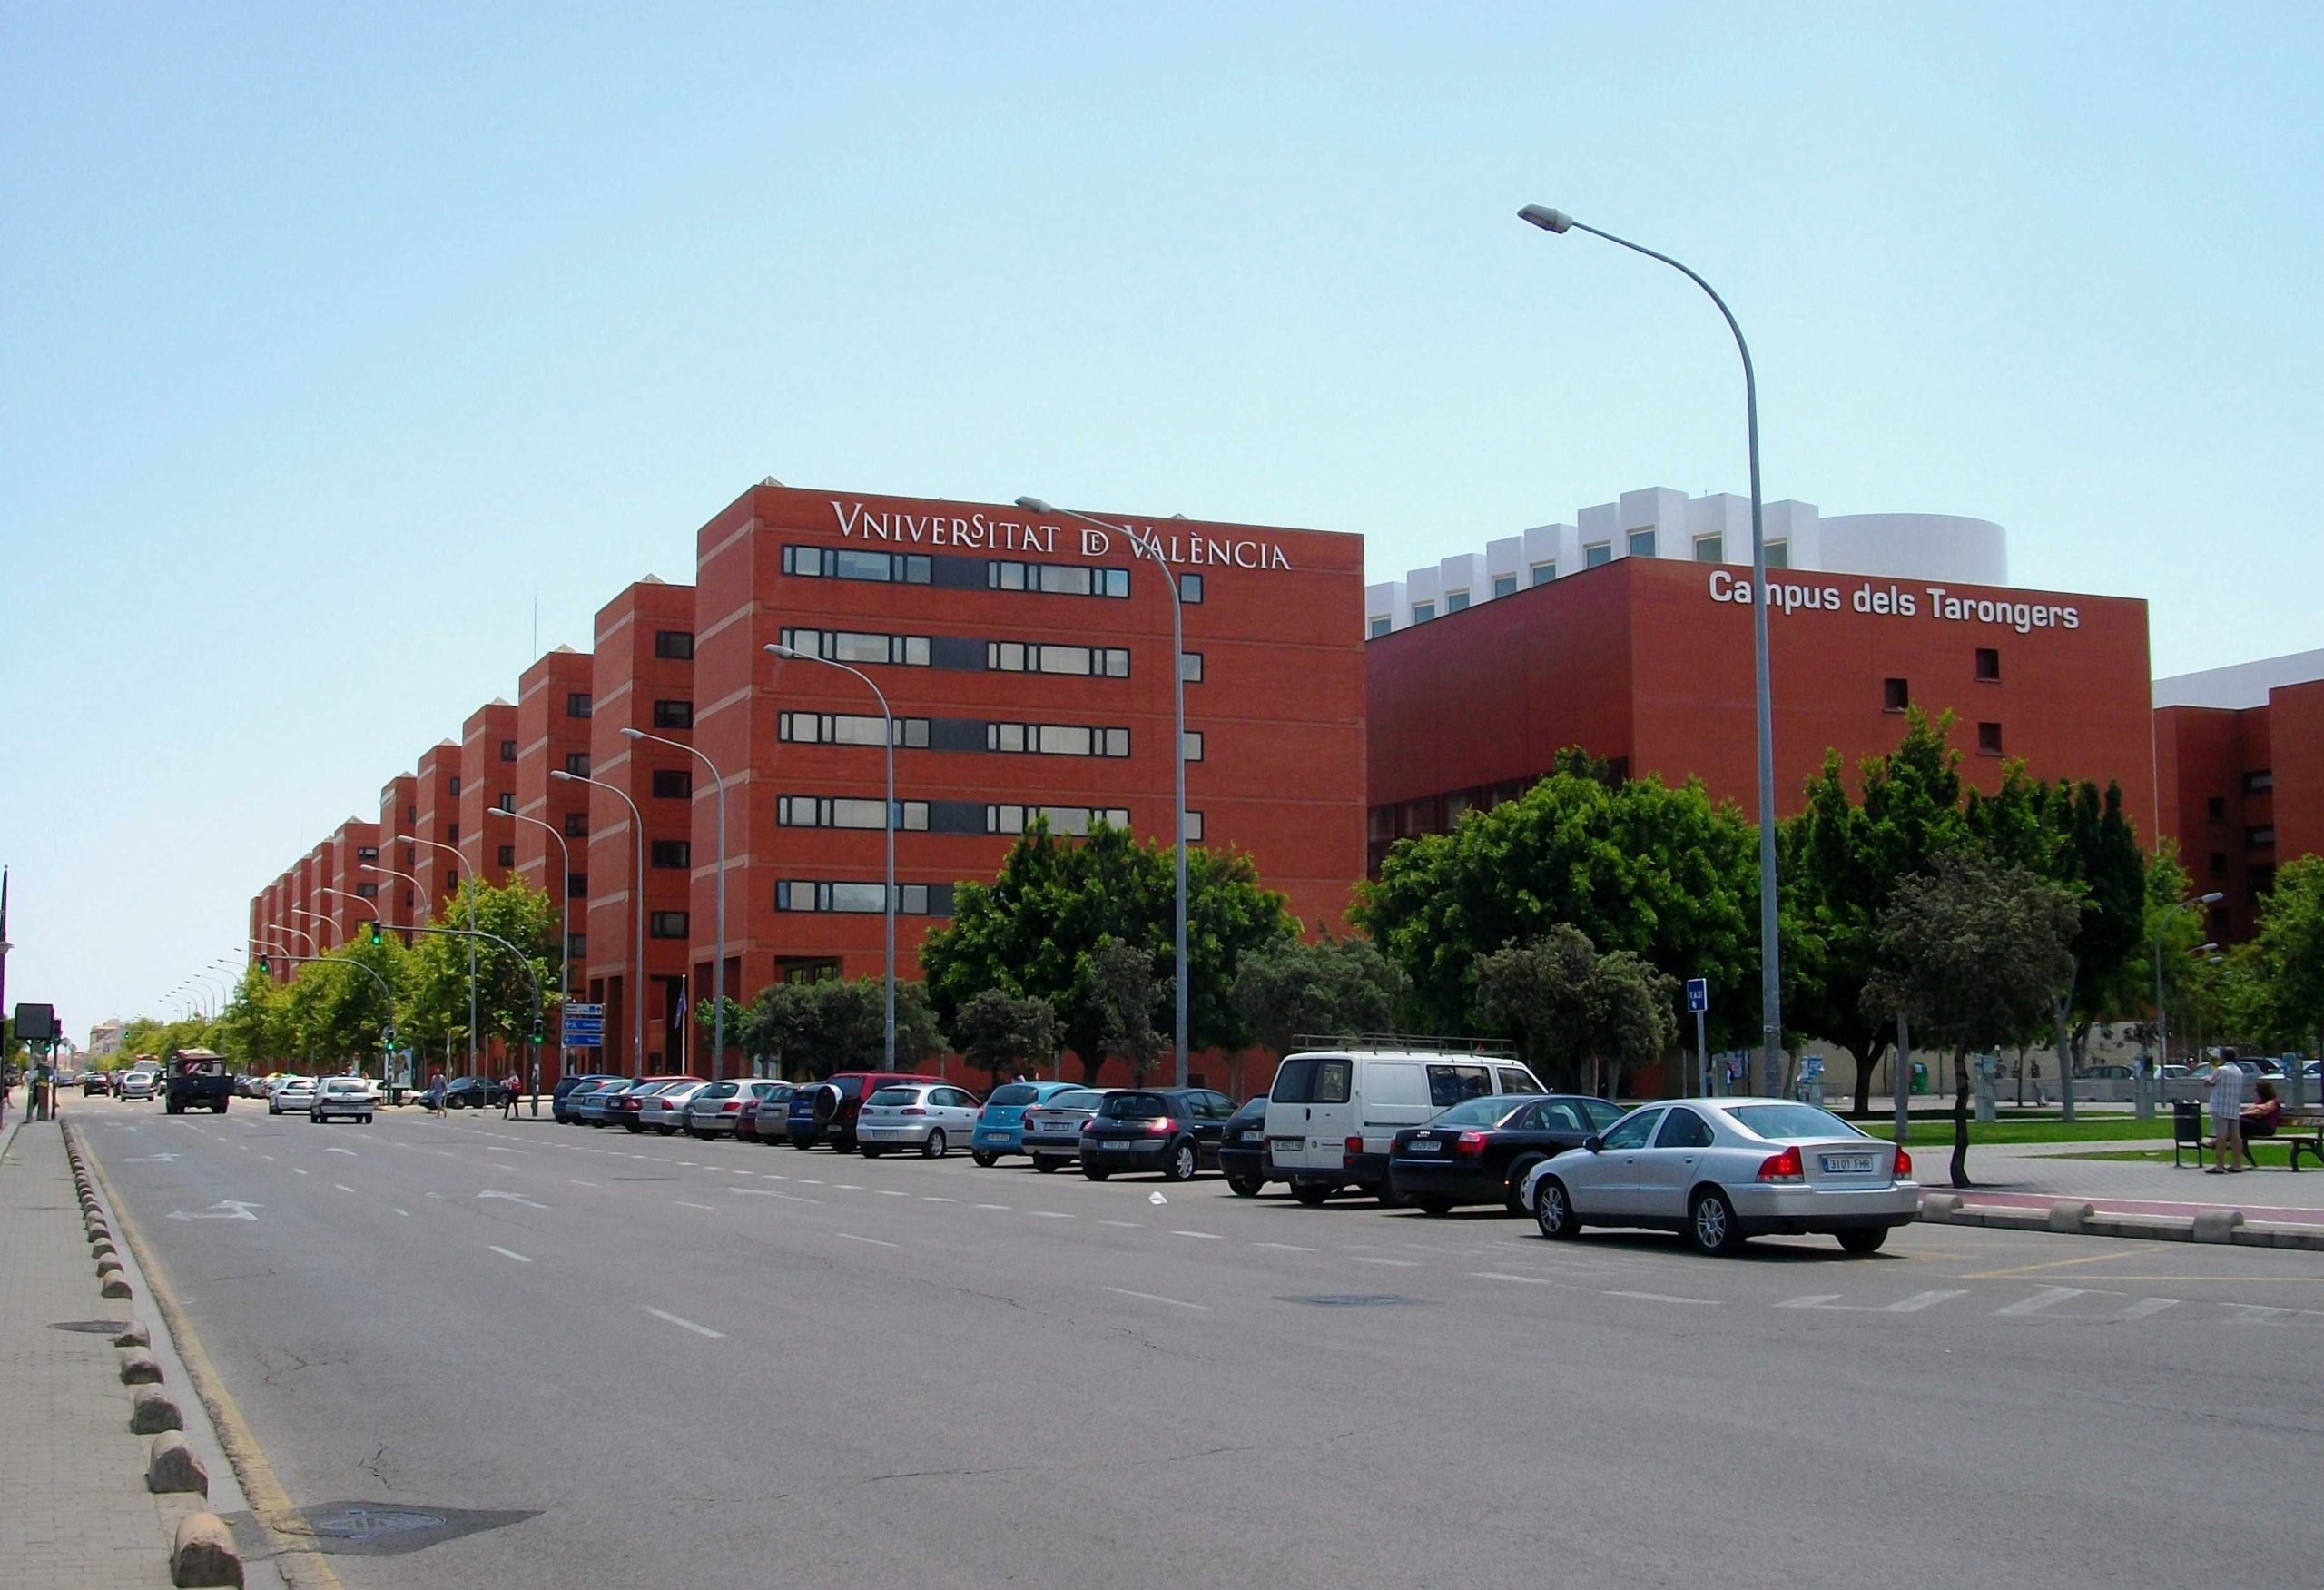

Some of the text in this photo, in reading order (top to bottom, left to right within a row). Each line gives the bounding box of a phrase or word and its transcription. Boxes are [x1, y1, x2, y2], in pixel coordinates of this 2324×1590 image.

[1709, 570, 2080, 634] Campus dels Tarongers
[1689, 991, 1703, 999] TAXI
[1830, 1158, 1871, 1170] 3101 FHR
